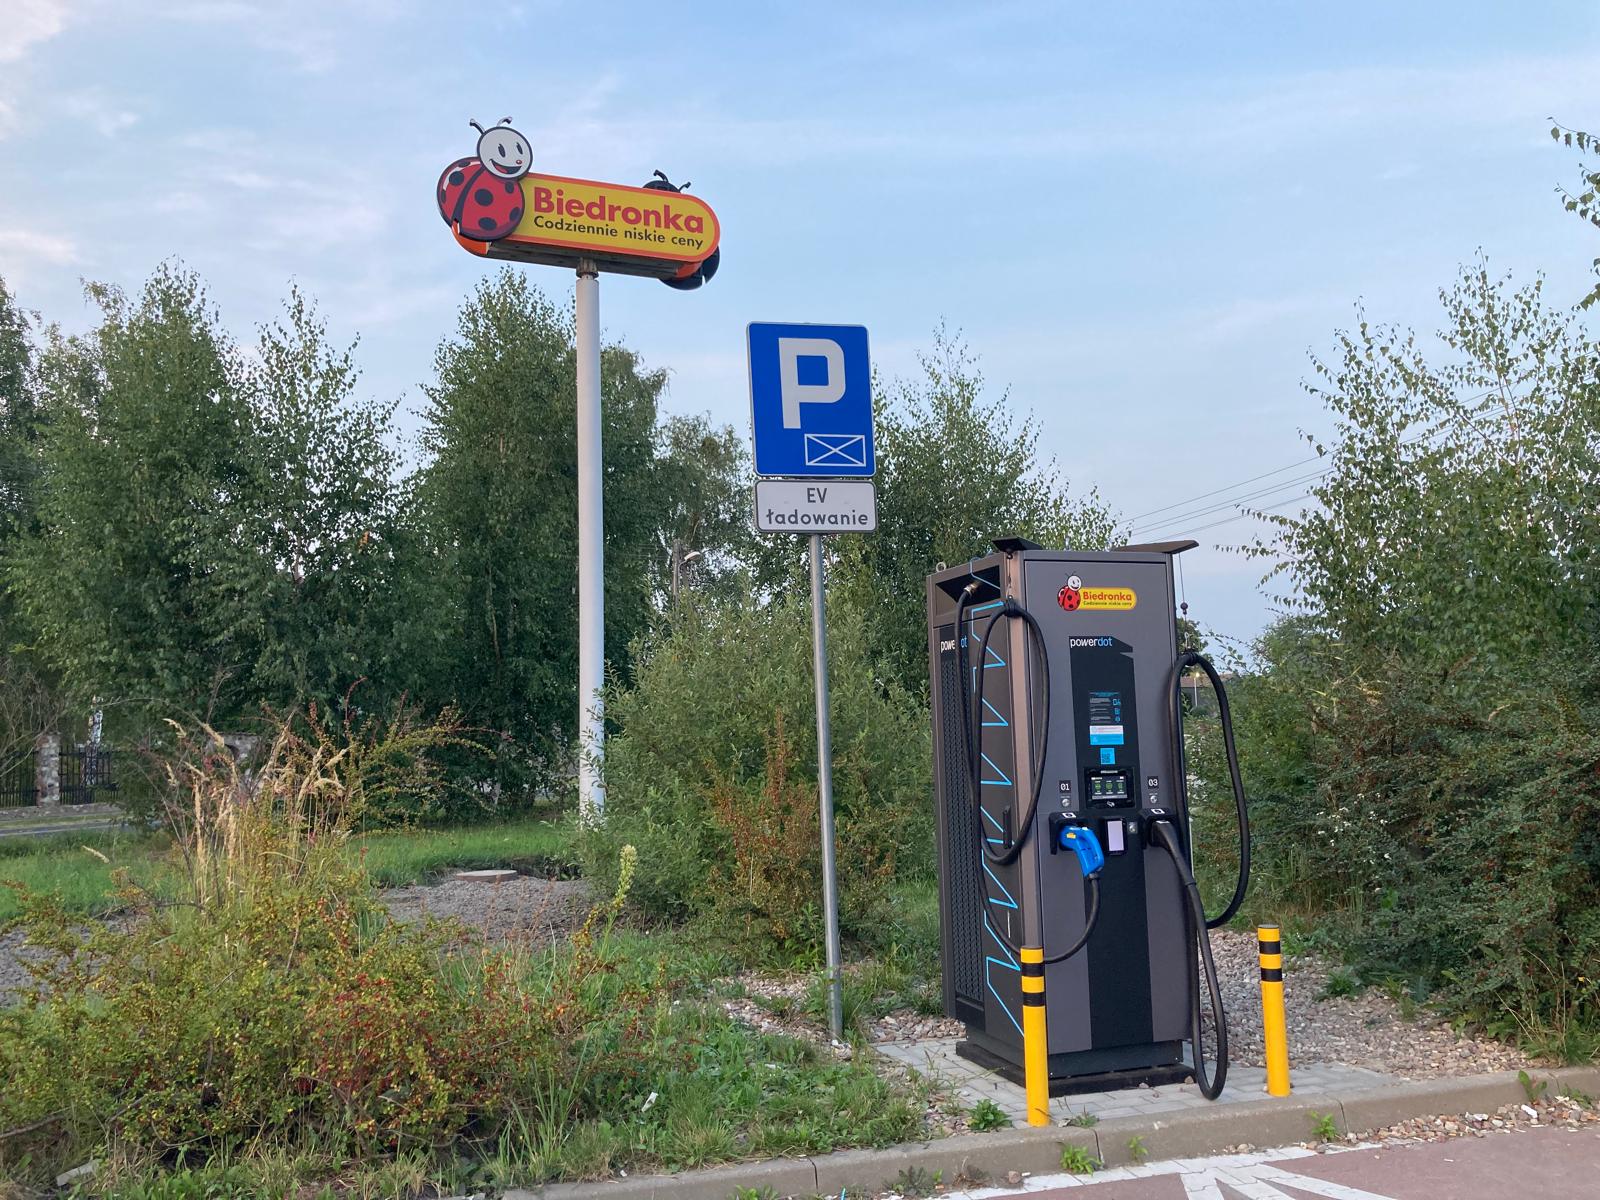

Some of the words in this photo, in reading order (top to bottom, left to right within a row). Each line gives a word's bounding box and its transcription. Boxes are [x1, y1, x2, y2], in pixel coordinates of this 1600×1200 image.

[534, 187, 704, 234] Biedronka
[533, 215, 618, 238] Codziennie
[624, 227, 665, 243] niskie
[671, 236, 703, 250] ceny
[778, 337, 846, 429] P
[806, 487, 828, 504] EV
[766, 508, 869, 526] ładowanie
[1082, 591, 1132, 601] Biedronka
[1070, 637, 1113, 648] powerdot
[1060, 783, 1070, 791] 01
[1148, 778, 1158, 787] 03
